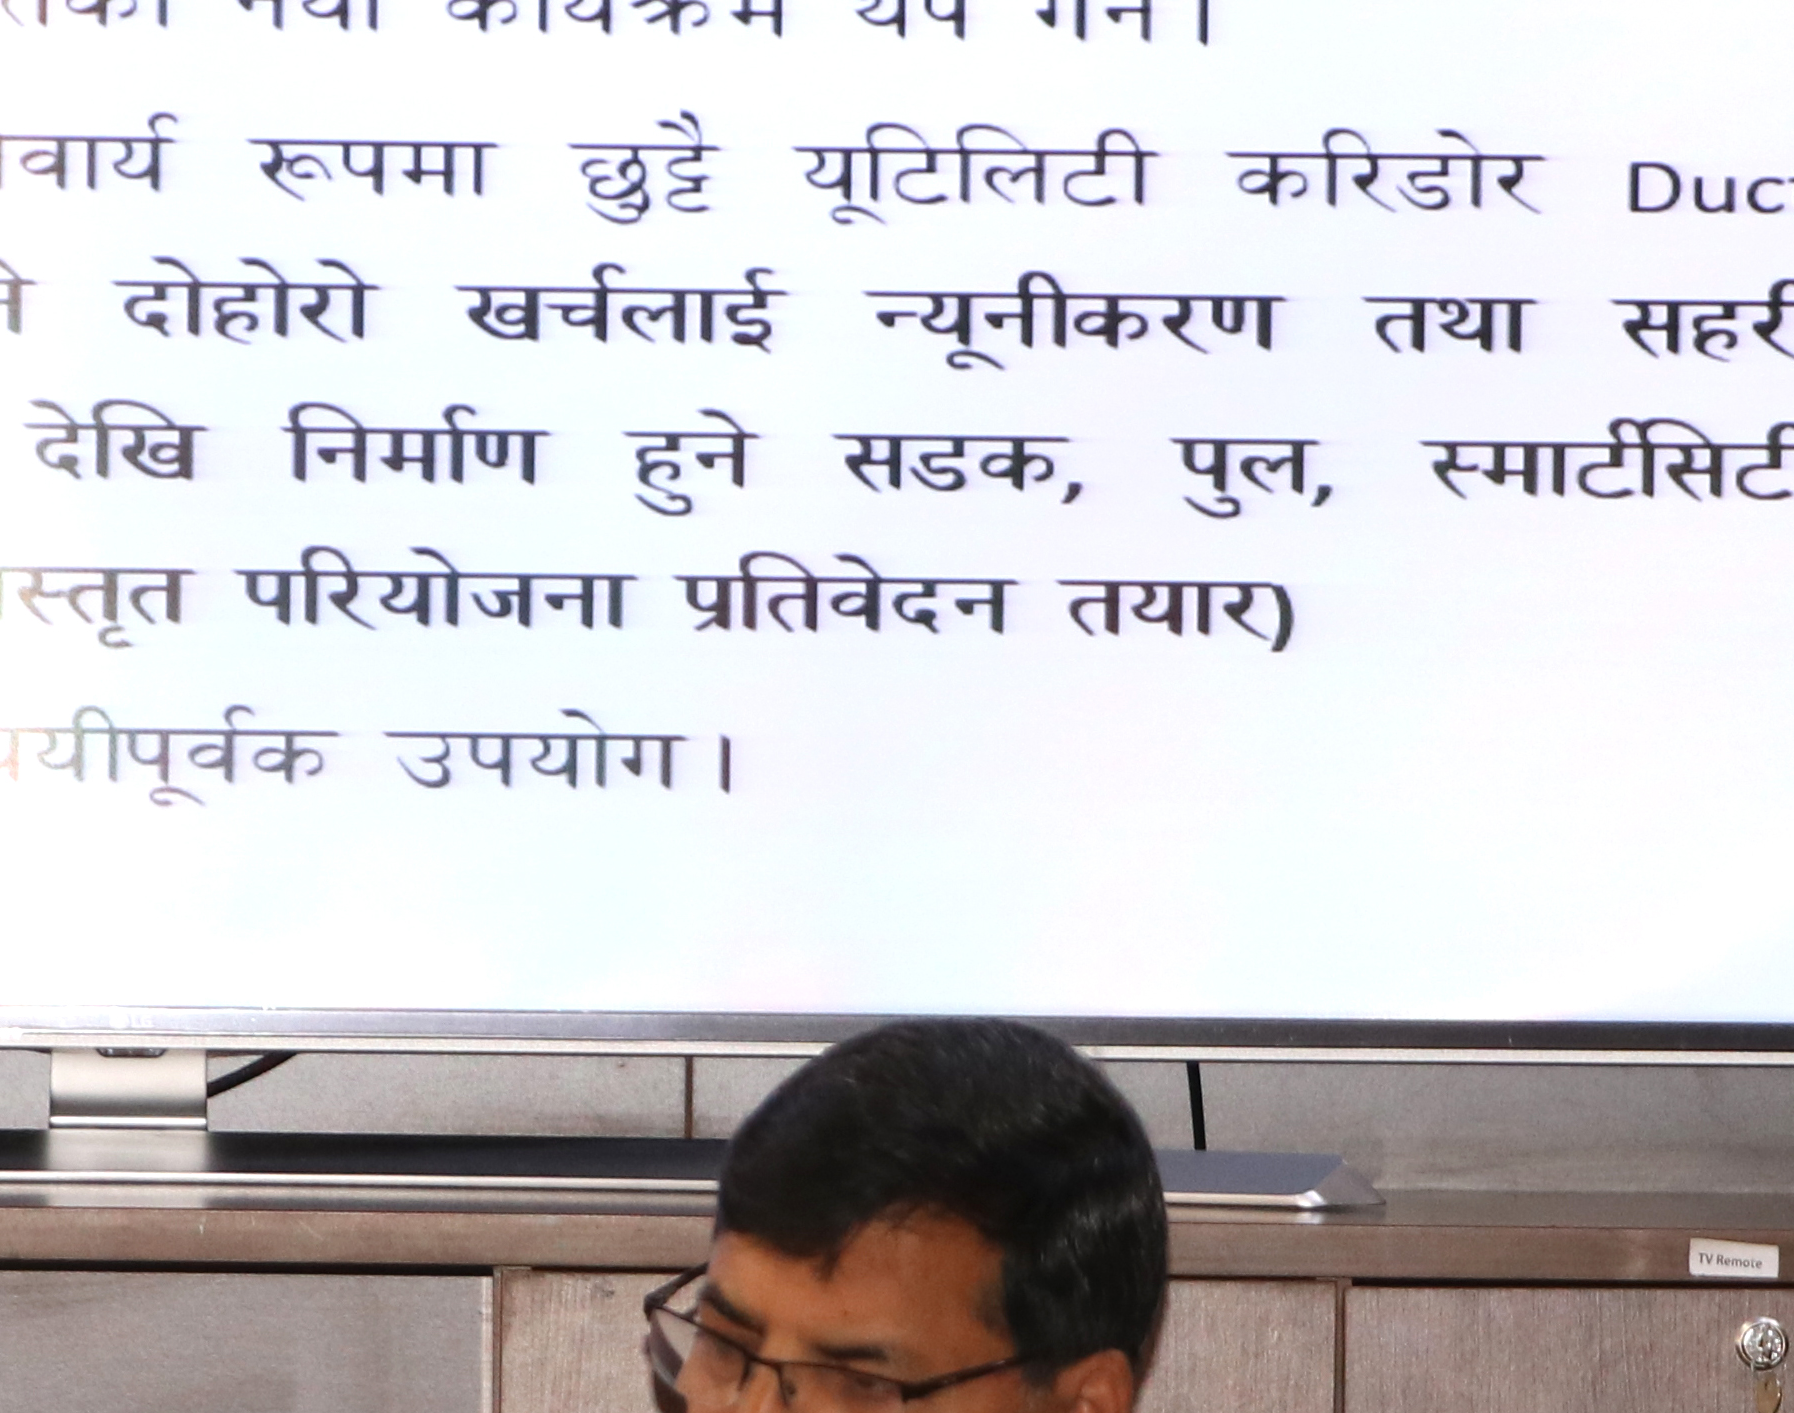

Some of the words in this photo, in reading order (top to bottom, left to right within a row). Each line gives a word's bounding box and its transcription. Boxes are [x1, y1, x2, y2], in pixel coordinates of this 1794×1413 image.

[246, 138, 501, 202] रूपमा
[567, 109, 723, 226] छुट्टै
[792, 122, 1162, 226] यूटिलिटी
[1224, 127, 1549, 214] करिडोर
[111, 255, 383, 345] दोहोरो
[454, 262, 791, 354] खर्चलाई
[863, 270, 1290, 371] न्यूनीकरण
[1361, 296, 1541, 354] तथा
[24, 399, 211, 481] देखि
[280, 401, 553, 486] निर्माण
[622, 408, 763, 517] हुने
[831, 433, 1084, 505] सडक,
[1169, 437, 1334, 520] पुल,
[233, 545, 639, 630] परियोजना
[672, 551, 1021, 635] प्रतिवेदन
[1055, 579, 1295, 653] तयार)
[1699, 1252, 1713, 1265] TV
[1716, 1254, 1763, 1269] Remote
